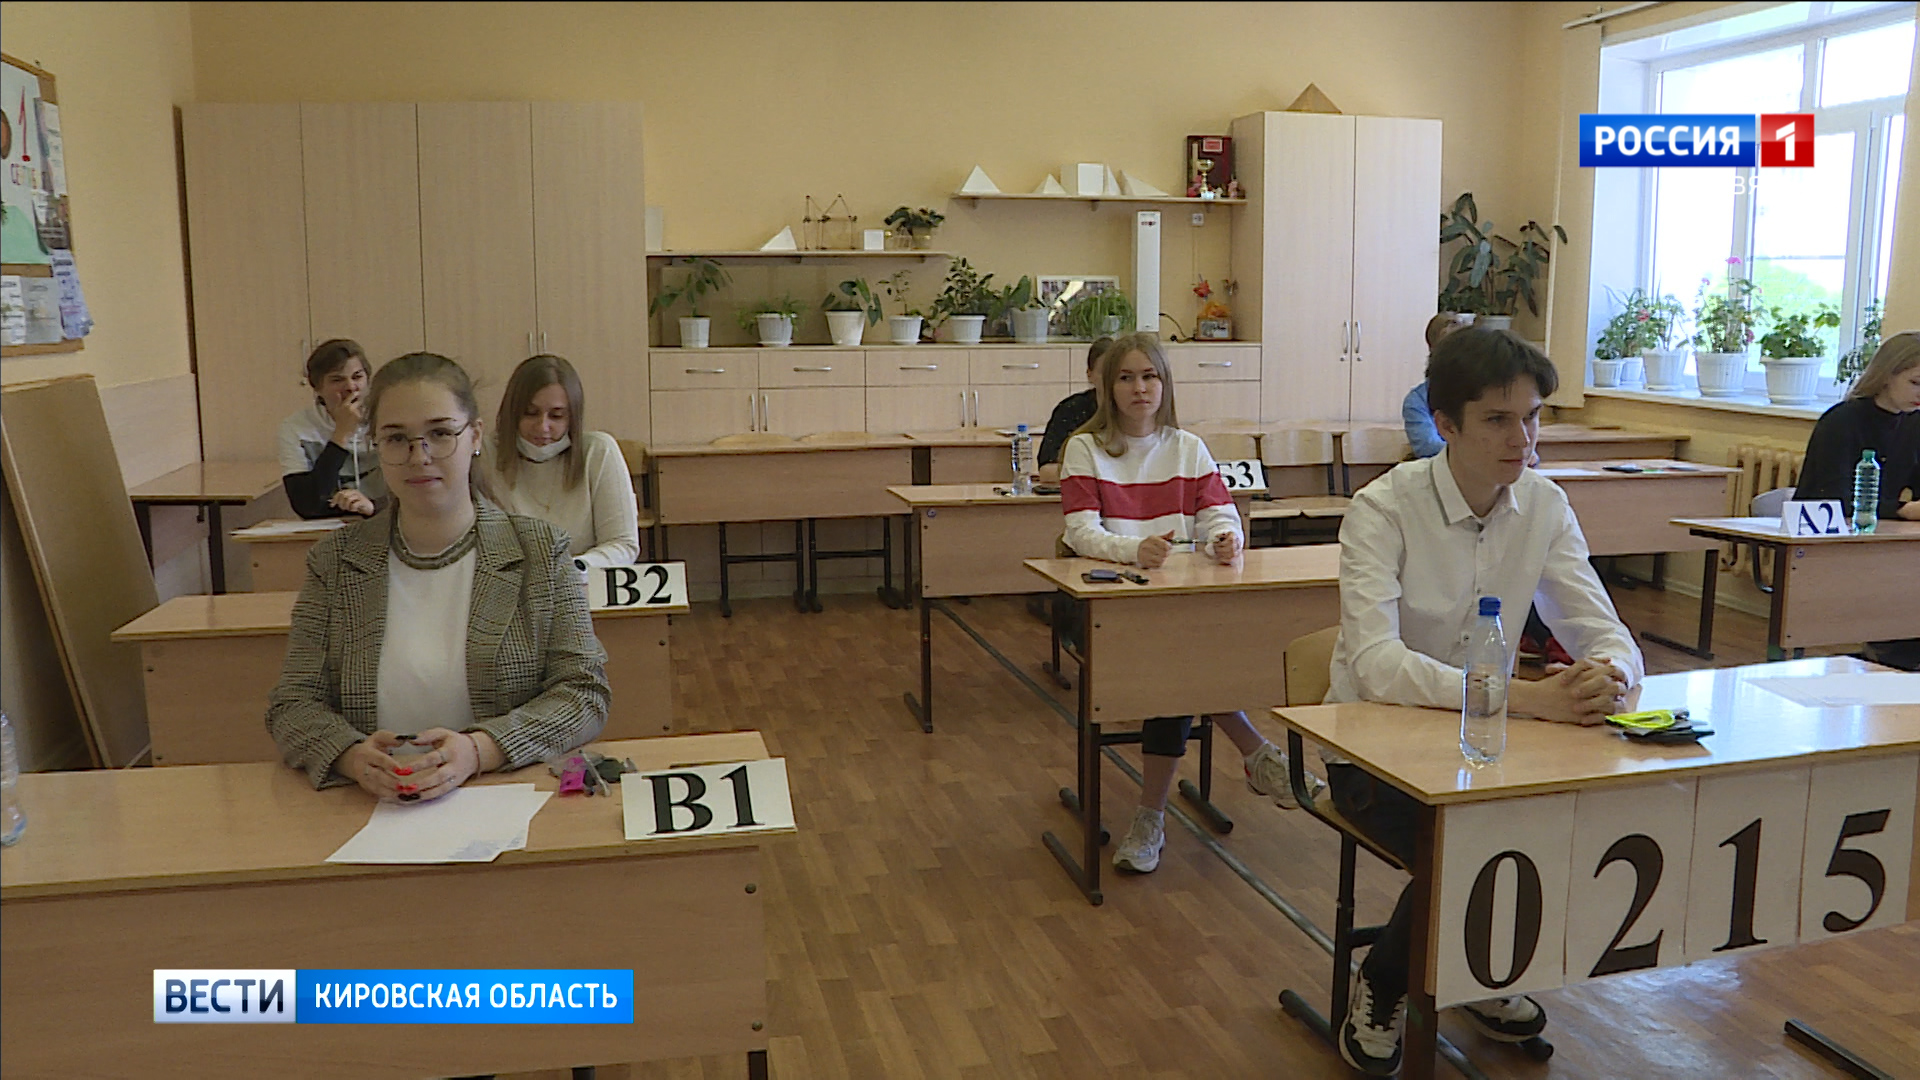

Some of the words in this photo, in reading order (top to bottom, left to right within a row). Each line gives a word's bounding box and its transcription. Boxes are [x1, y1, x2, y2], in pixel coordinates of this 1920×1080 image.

[1797, 502, 1840, 536] А2
[601, 565, 672, 608] В2
[641, 765, 766, 836] В1
